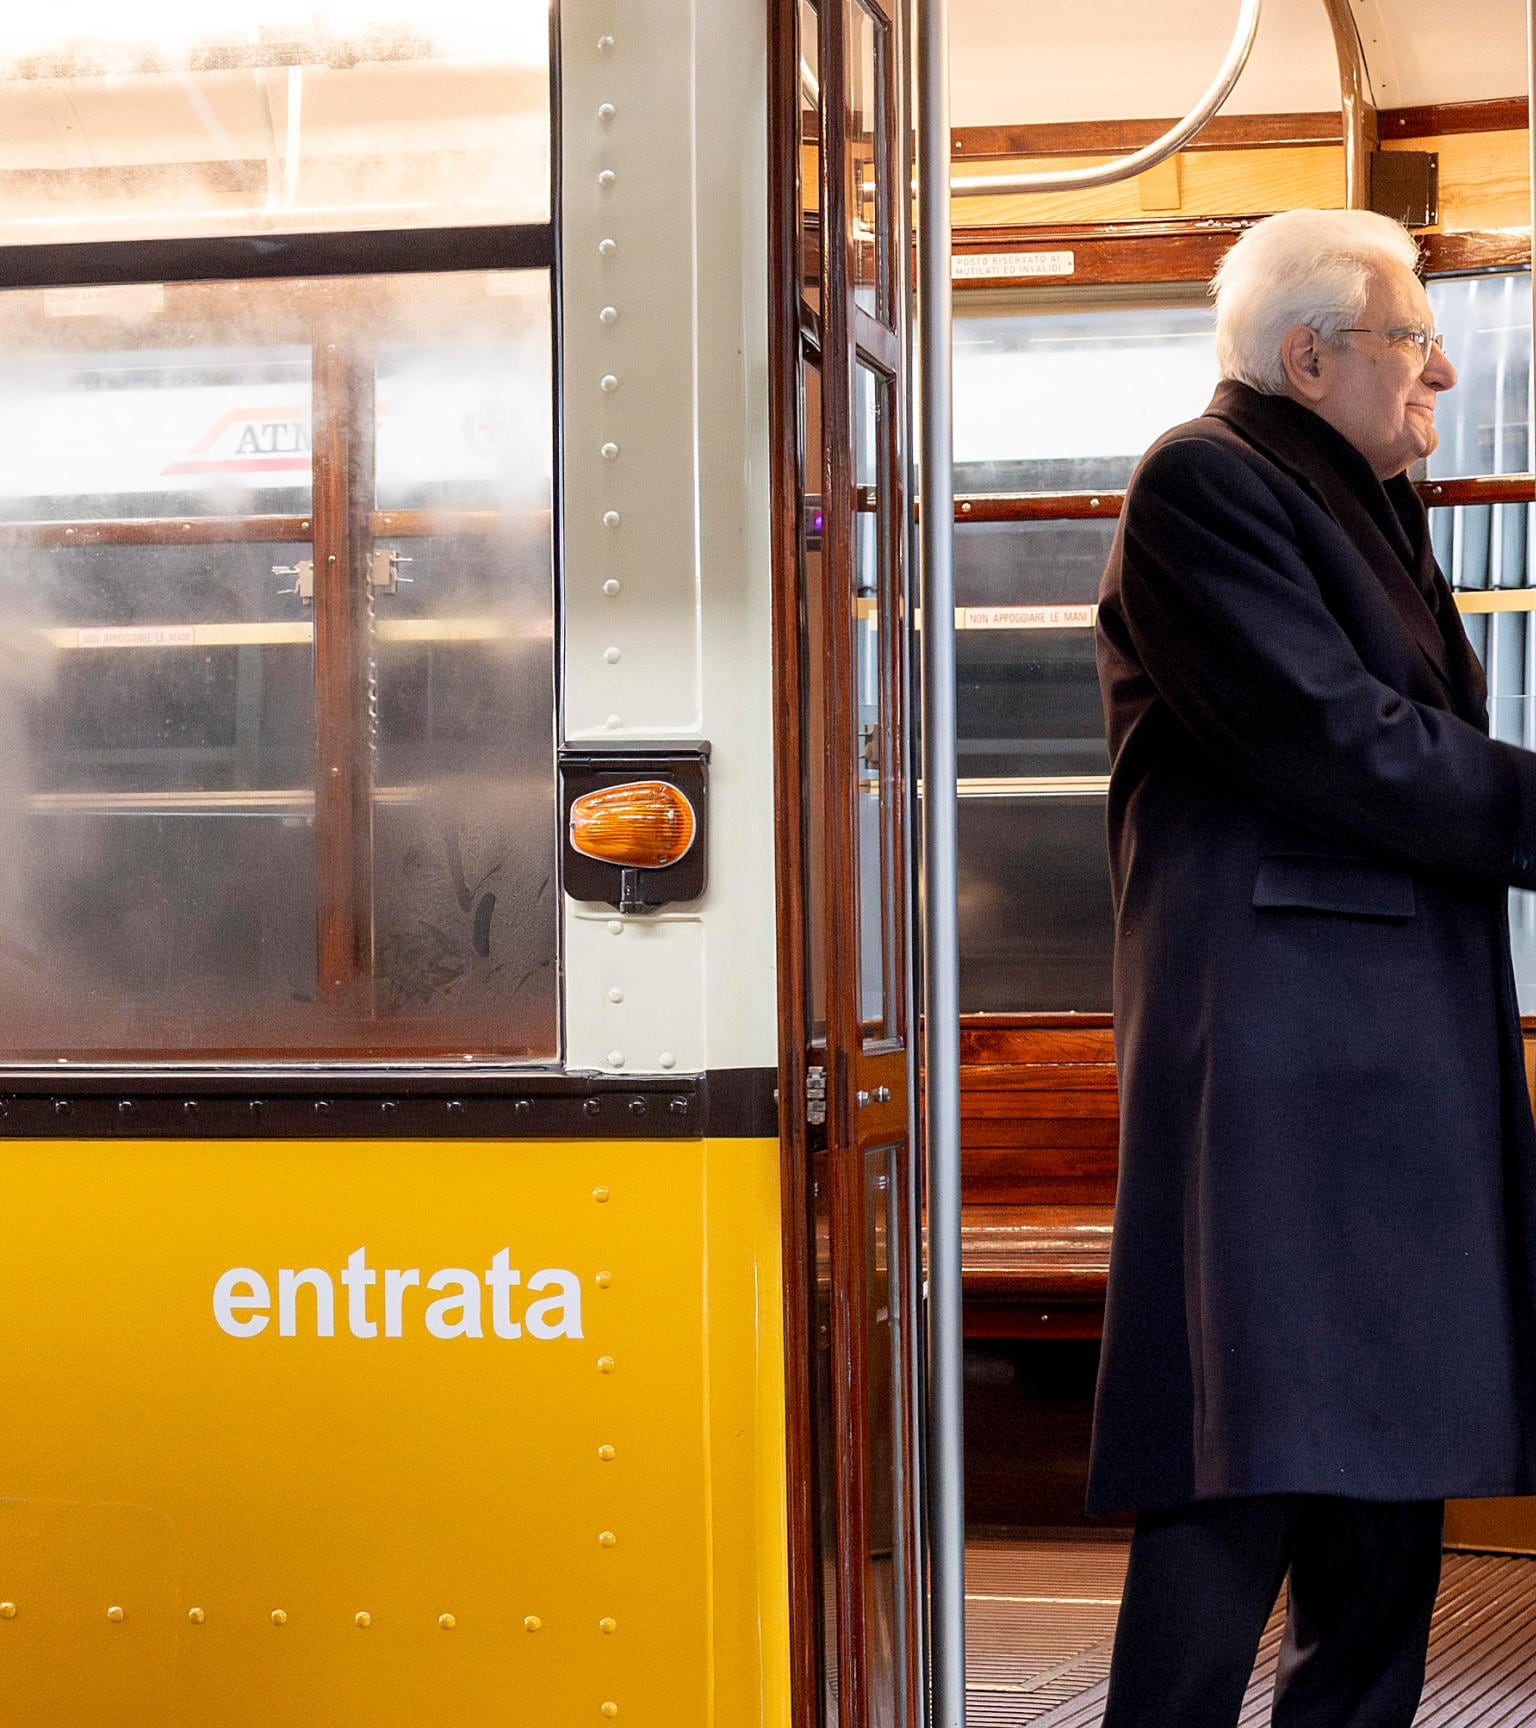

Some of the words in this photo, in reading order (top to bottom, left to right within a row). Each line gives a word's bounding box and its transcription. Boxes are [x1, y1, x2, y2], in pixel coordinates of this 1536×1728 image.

[956, 257, 988, 266] POSTO
[992, 255, 1046, 265] RISERVATO
[1050, 255, 1060, 263] AI
[956, 266, 1000, 276] MUTILATI
[1003, 266, 1016, 274] ED
[1019, 264, 1061, 274] INVALIDI
[969, 613, 989, 624] NON
[992, 612, 1046, 624] APPOGGIARE
[1050, 612, 1059, 622] LE
[1063, 611, 1088, 622] MANI
[212, 1246, 584, 1339] entrata
